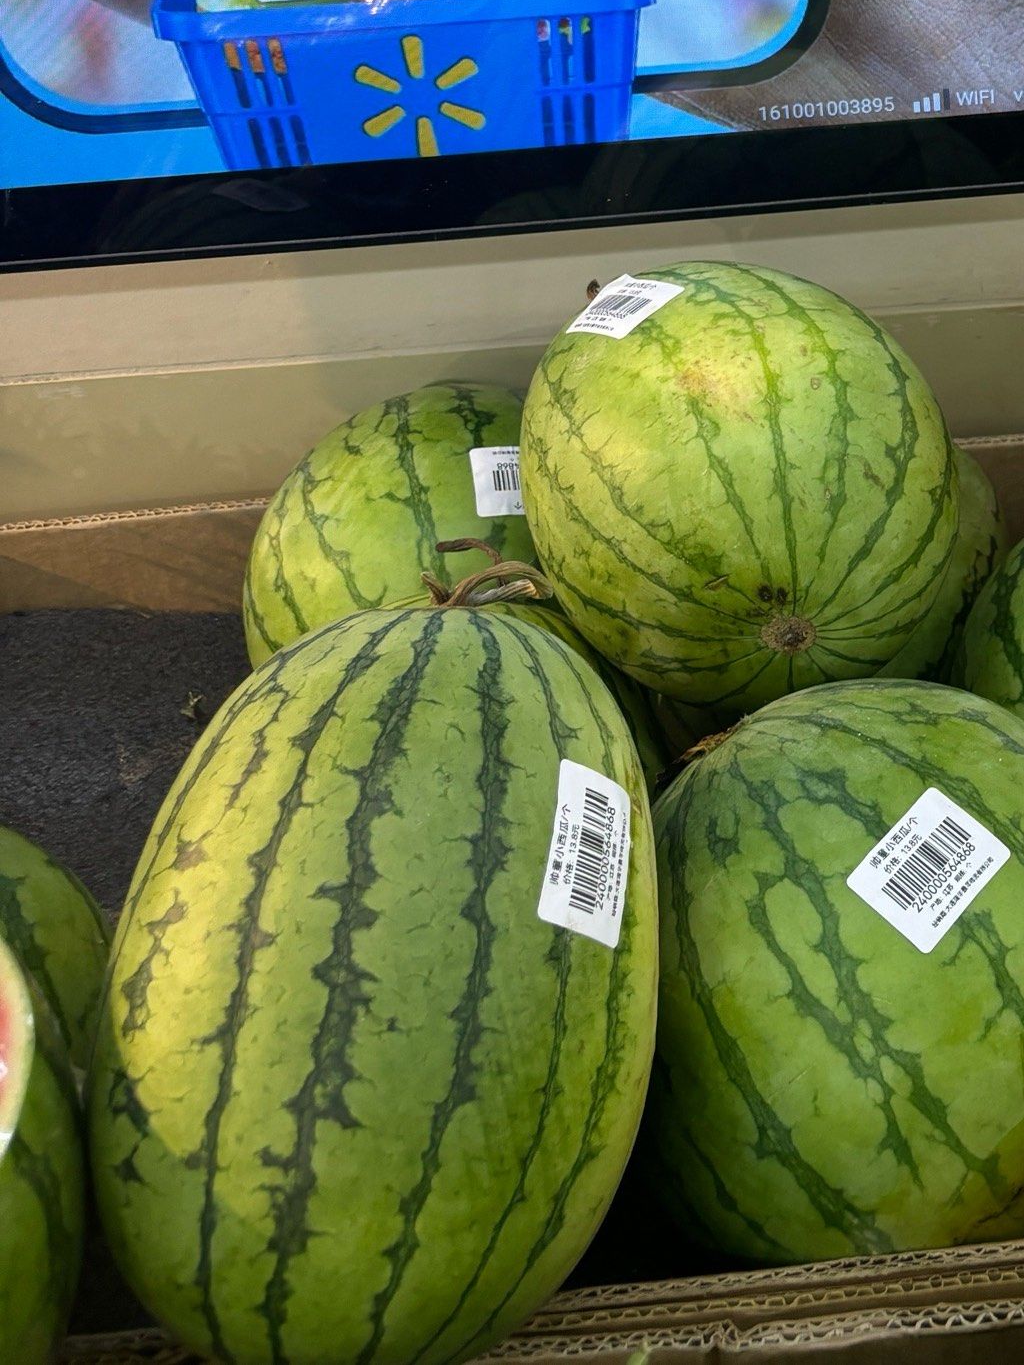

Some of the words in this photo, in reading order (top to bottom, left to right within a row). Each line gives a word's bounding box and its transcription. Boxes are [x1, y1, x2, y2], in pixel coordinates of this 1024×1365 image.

[758, 96, 895, 122] 161001003895
[956, 88, 996, 107] WIFI
[549, 803, 572, 885] 帅童小西瓜/个
[567, 823, 580, 853] 13.8元
[594, 807, 617, 909] 240000564868
[869, 815, 919, 868] 帅童小西瓜/个
[901, 833, 922, 855] 13.8元
[911, 841, 977, 912] 240000564868
